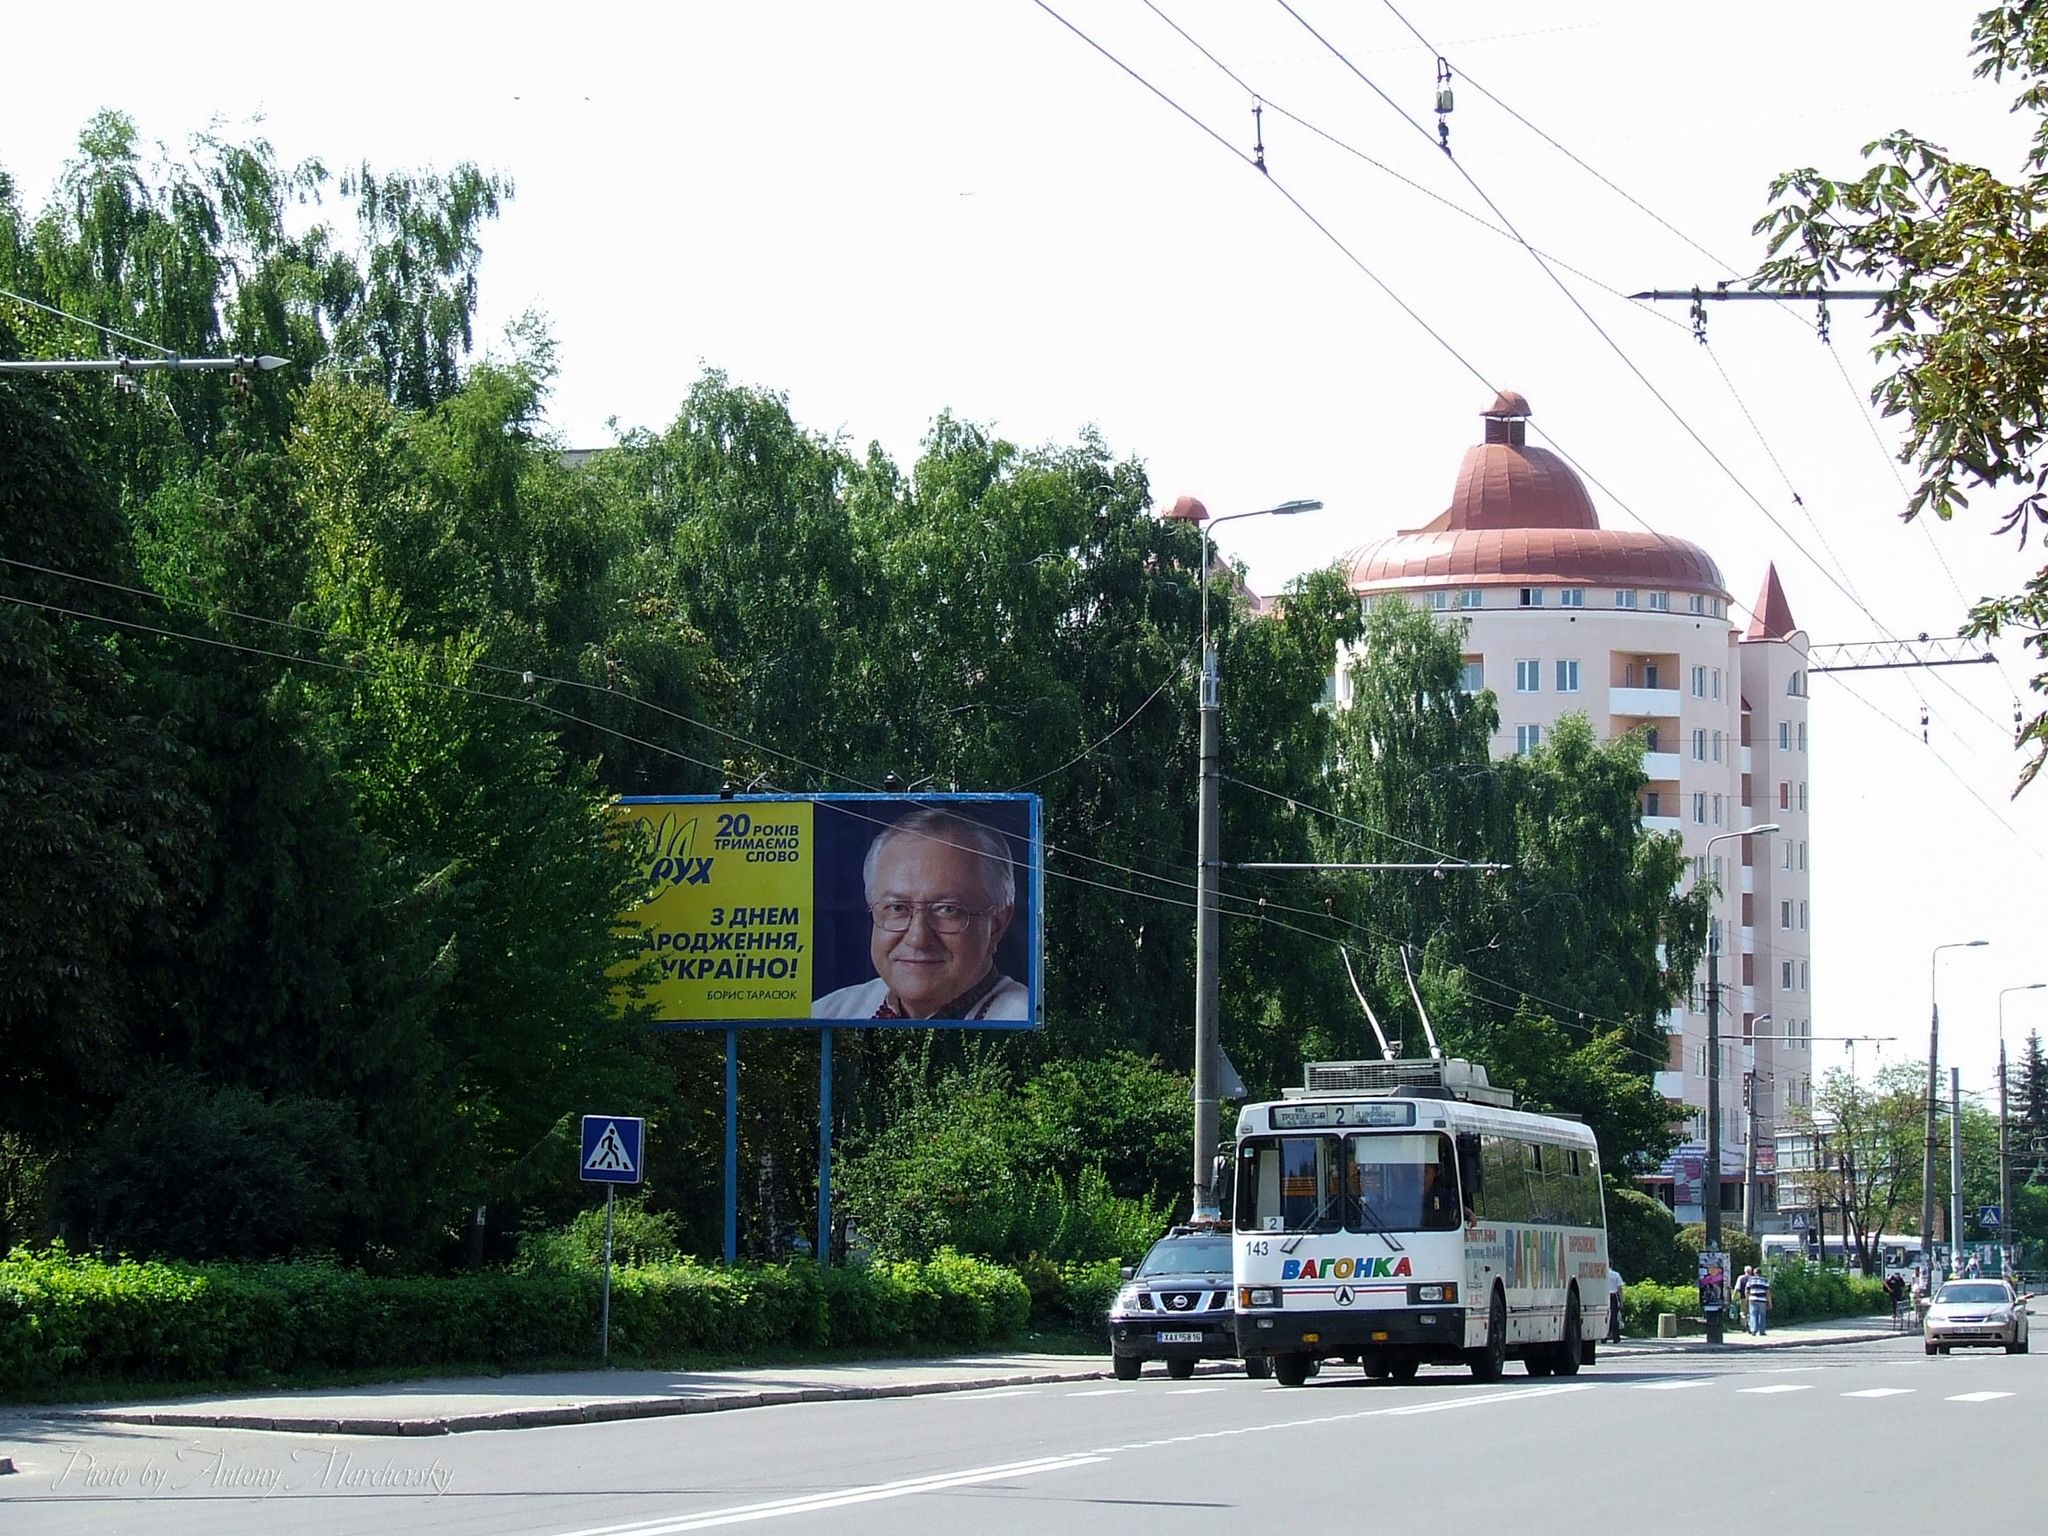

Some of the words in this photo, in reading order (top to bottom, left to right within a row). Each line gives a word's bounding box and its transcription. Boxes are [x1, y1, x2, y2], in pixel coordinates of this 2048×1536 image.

[716, 813, 750, 837] 20
[753, 825, 799, 836] РОКІВ
[714, 838, 799, 850] ТРИМАЄМО
[746, 851, 799, 863] СЛОВО
[710, 908, 724, 925] З
[729, 908, 799, 928] ДНЕМ
[638, 932, 805, 953] АРОДЖЕННЯ,
[661, 953, 798, 980] УКРАЇНО!
[707, 990, 745, 1000] БОРИС
[747, 990, 797, 1000] ТАРАСЮК
[1335, 1107, 1345, 1125] 2
[1269, 1218, 1277, 1230] 2
[1246, 1241, 1269, 1256] 143
[1282, 1257, 1413, 1280] ВАГОНКА
[1505, 1229, 1566, 1289] ВАГОНКА
